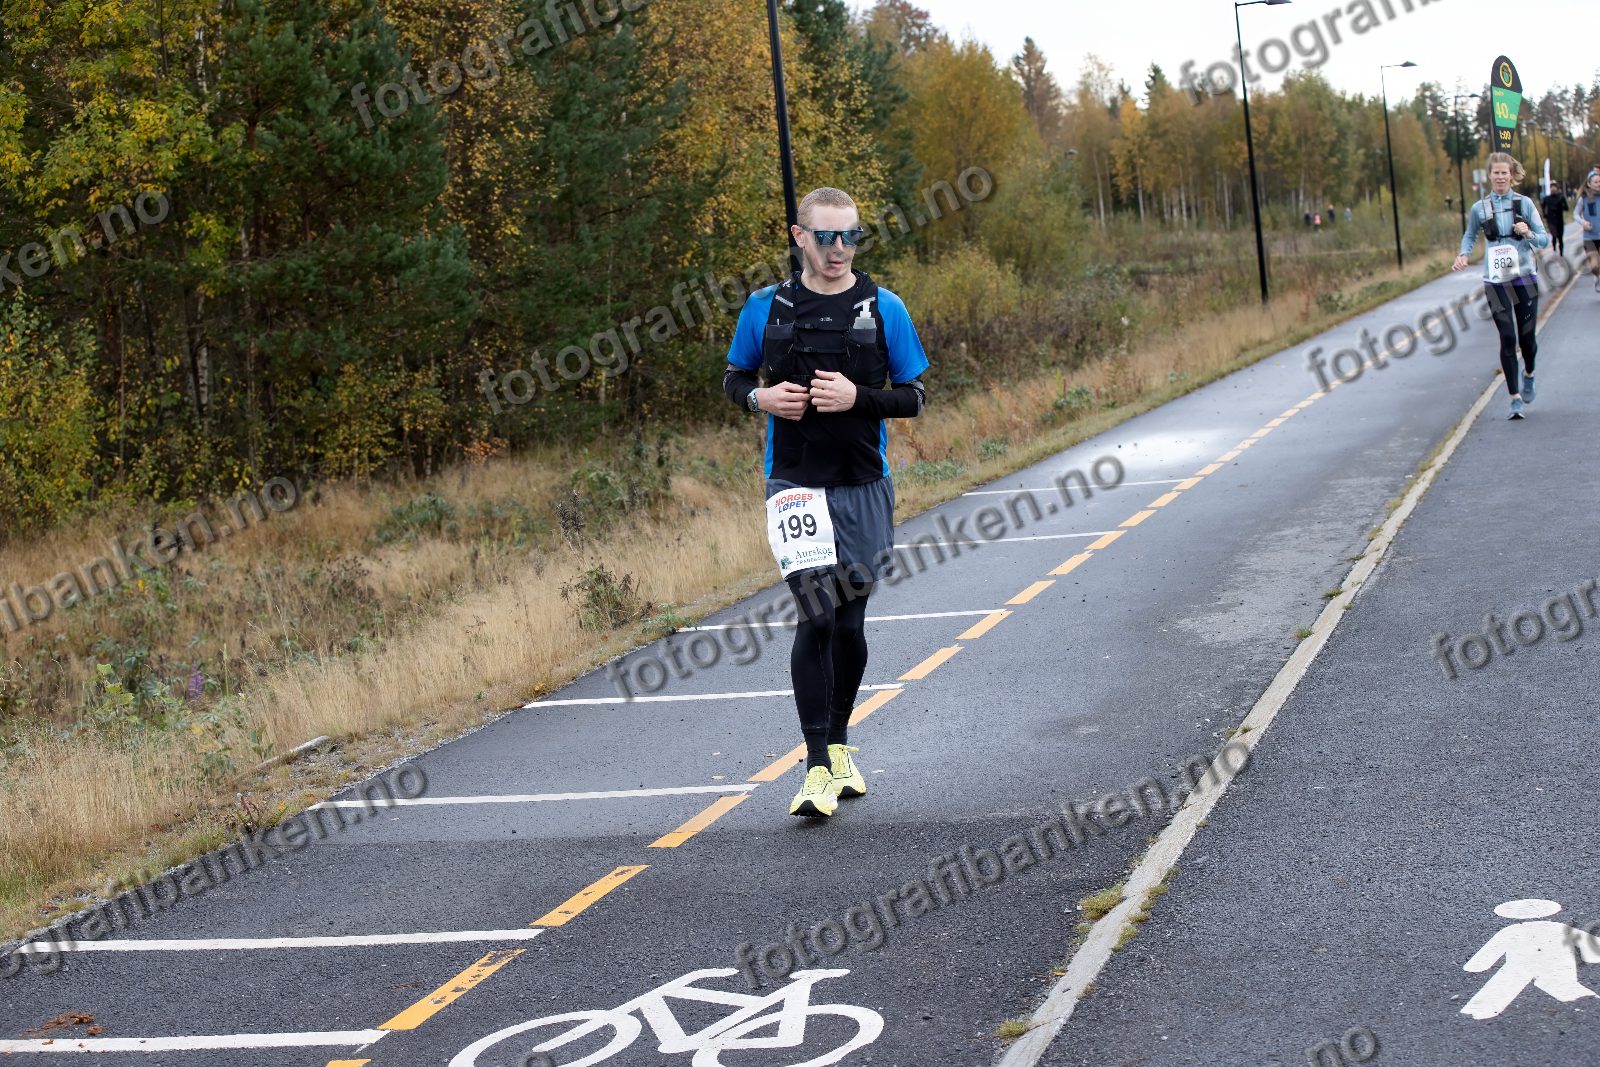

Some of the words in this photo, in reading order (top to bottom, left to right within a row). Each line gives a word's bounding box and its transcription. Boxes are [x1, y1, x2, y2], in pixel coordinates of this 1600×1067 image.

[1494, 257, 1513, 269] 882
[775, 493, 813, 508] NORGES
[778, 500, 808, 514] LØPET
[777, 513, 817, 543] 199
[795, 546, 834, 560] Aurskog
